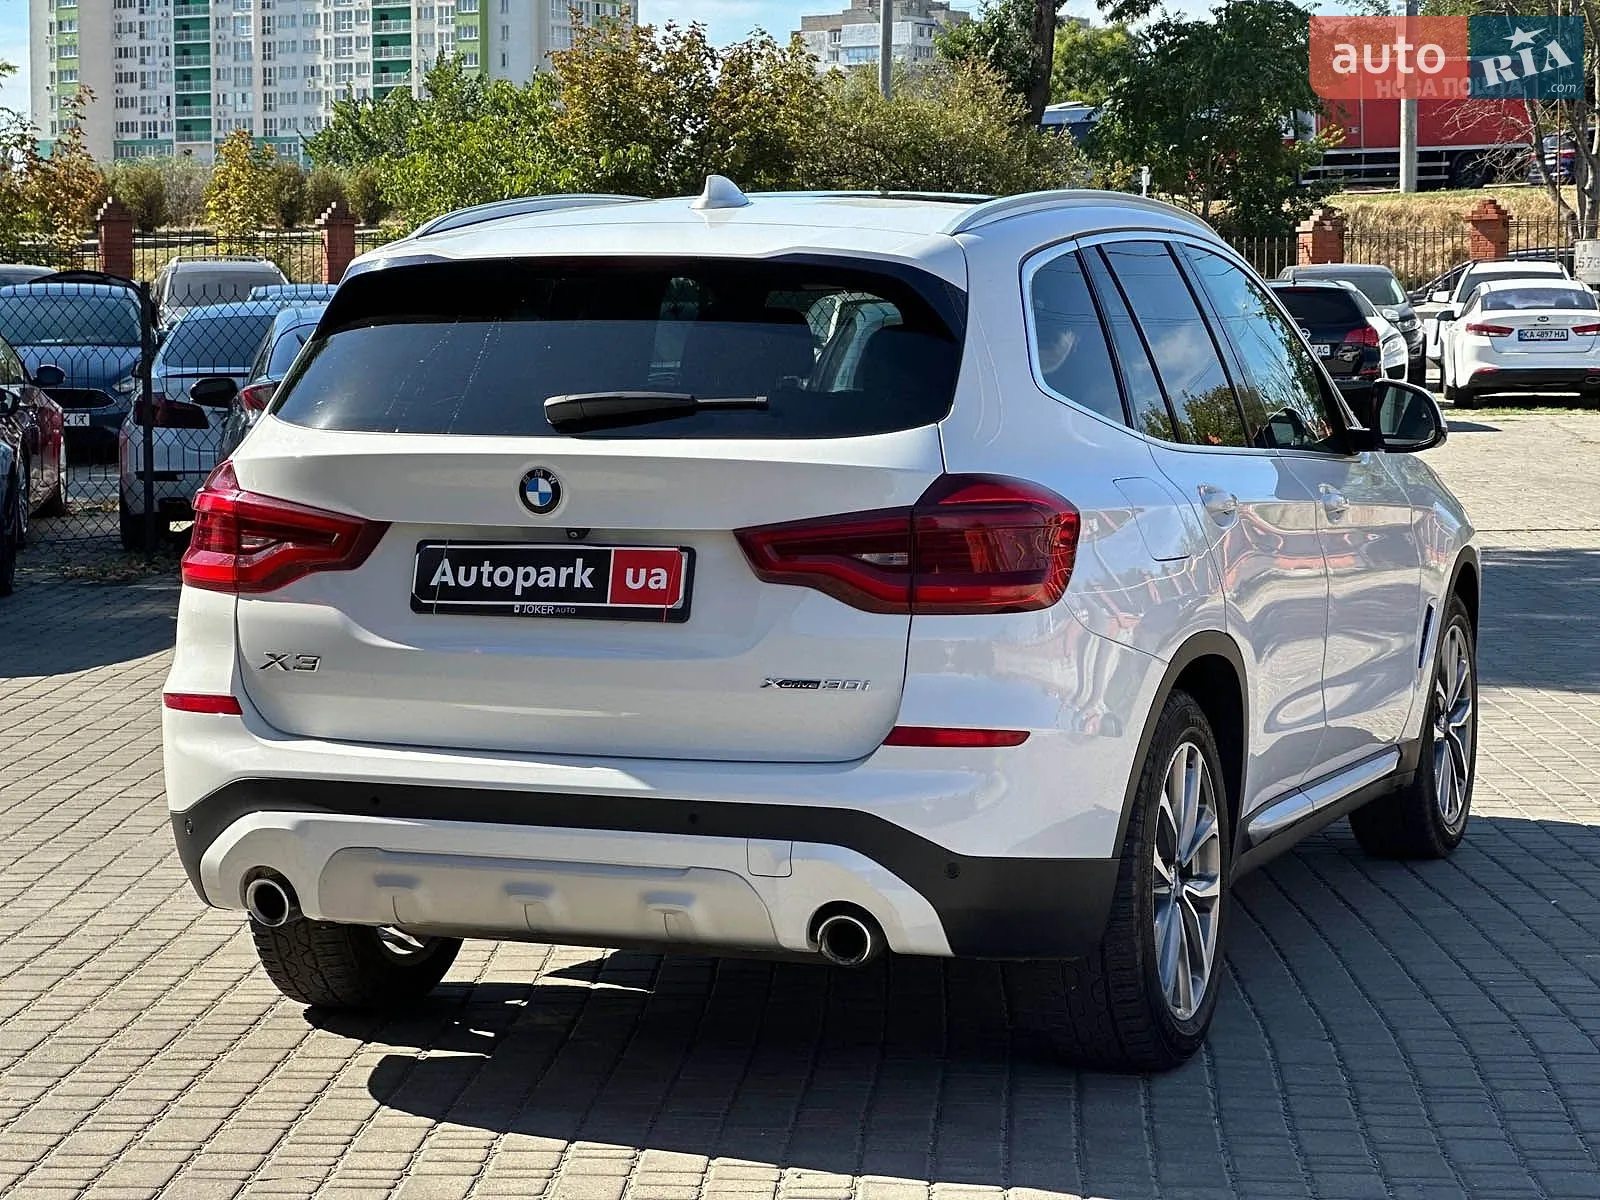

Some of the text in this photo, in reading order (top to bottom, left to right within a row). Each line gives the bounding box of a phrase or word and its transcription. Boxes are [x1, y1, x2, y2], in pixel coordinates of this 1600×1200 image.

[523, 469, 558, 485] BMW
[429, 557, 668, 596] Autopark ua
[522, 604, 576, 615] JOKER AUTO
[256, 651, 322, 673] X3
